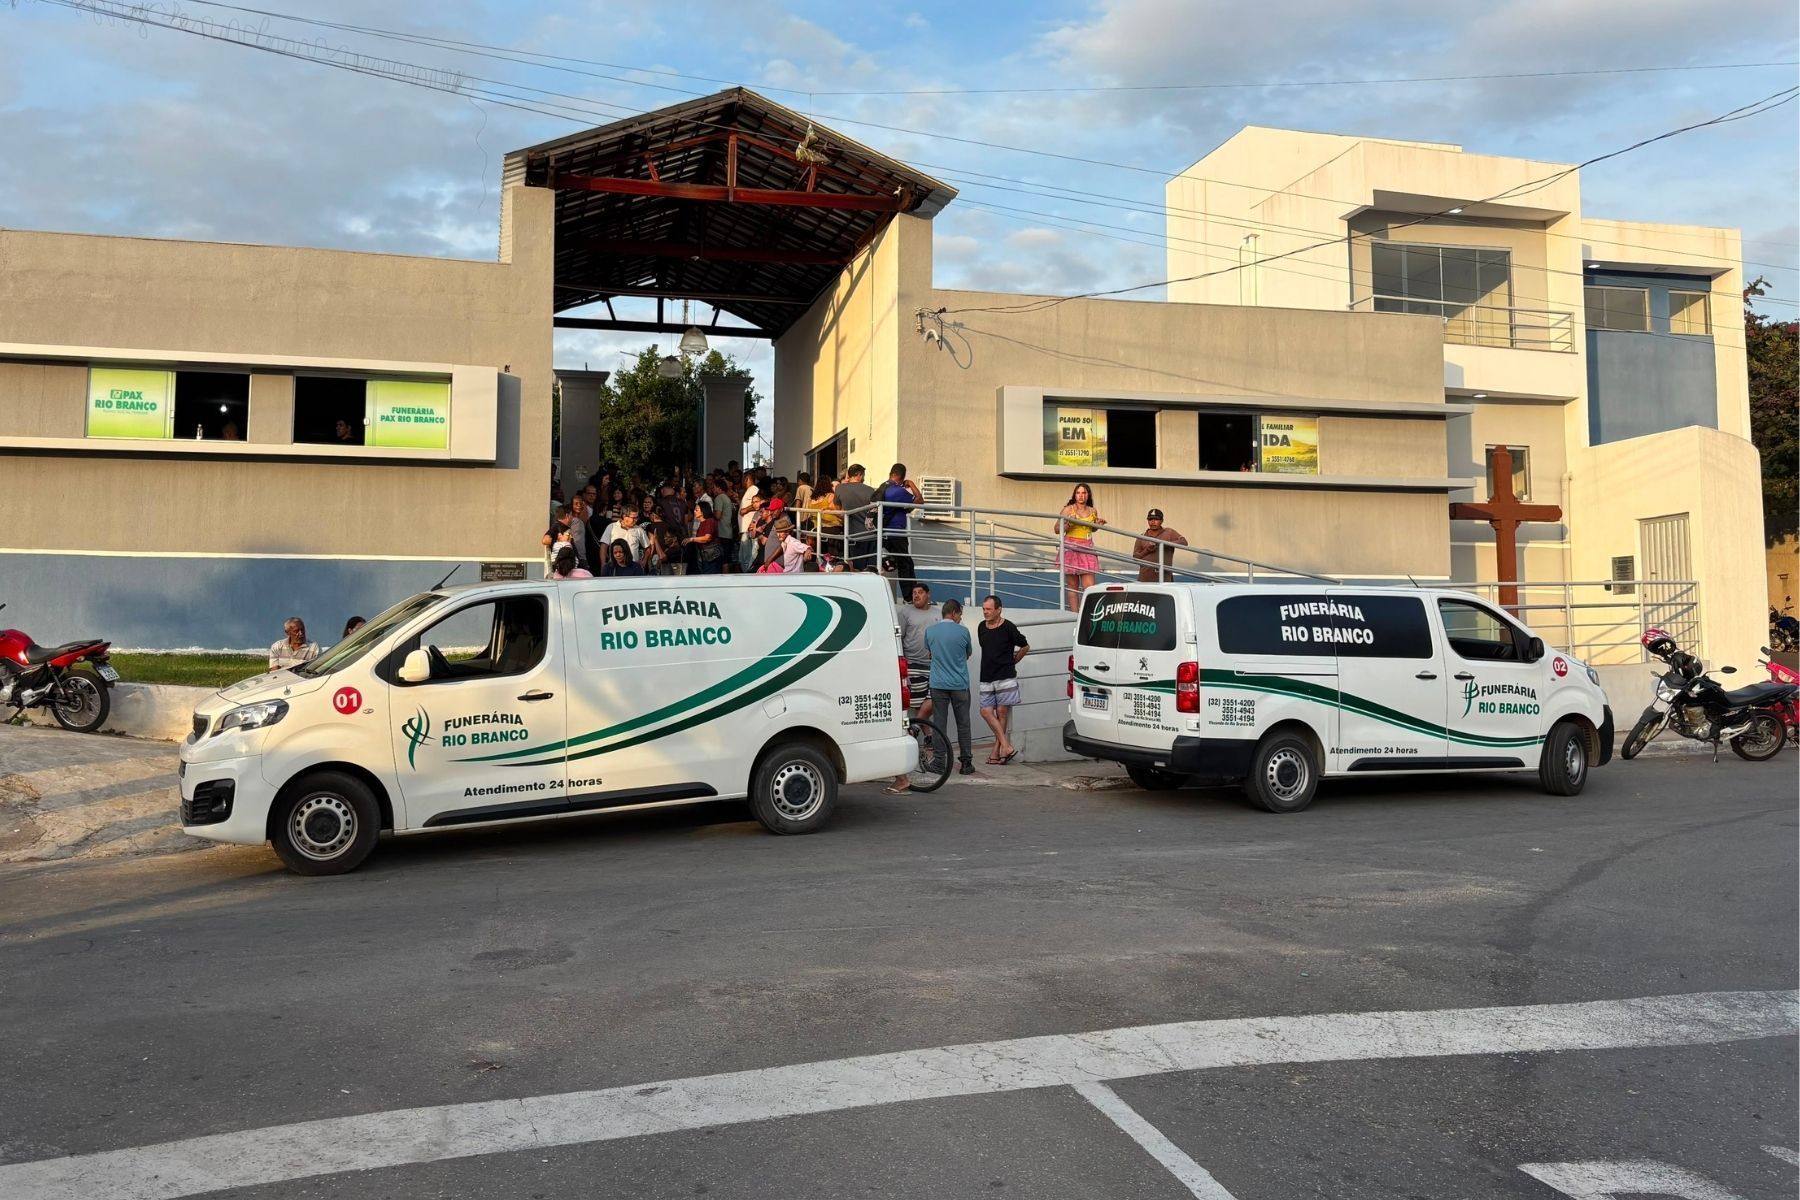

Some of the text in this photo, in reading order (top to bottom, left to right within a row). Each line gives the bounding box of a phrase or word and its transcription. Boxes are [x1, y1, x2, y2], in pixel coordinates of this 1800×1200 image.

[123, 390, 143, 400] PAX
[95, 399, 157, 411] RIO BRANCO
[380, 414, 446, 424] PAX RIO BRANCO
[1266, 423, 1294, 431] FAMILIAR
[1062, 427, 1086, 440] EM
[601, 595, 722, 626] FUNERÁRIA
[1105, 600, 1155, 619] FUNERÁRIA
[1279, 599, 1366, 622] FUNERÁRIA
[1101, 620, 1157, 634] RIO BRANCO
[600, 626, 732, 650] RIO BRANCO
[1281, 625, 1374, 645] RIO BRANCO
[1553, 661, 1567, 672] 02
[1481, 682, 1537, 701] FUNERÁRIA
[336, 692, 358, 709] 01
[838, 692, 892, 707] (32) 3551-4200
[1133, 693, 1161, 703] 3551-4200
[1208, 697, 1256, 707] (32) 3551-4200
[854, 700, 892, 712] 3551-4943
[1222, 706, 1255, 715] 3551-4943
[1478, 701, 1540, 715] RIO BRANCO
[854, 709, 892, 720] 3551-4194
[1133, 708, 1161, 718] 3551-4194
[1222, 713, 1255, 722] 3551-4194
[444, 710, 524, 732] FUNERÁRIA
[1118, 718, 1152, 729] Atendimento
[442, 728, 529, 747] RIO BRANCO
[1329, 747, 1382, 755] Atendimento
[1395, 747, 1418, 755] horas
[464, 777, 603, 797] Atendimento 24 horas
